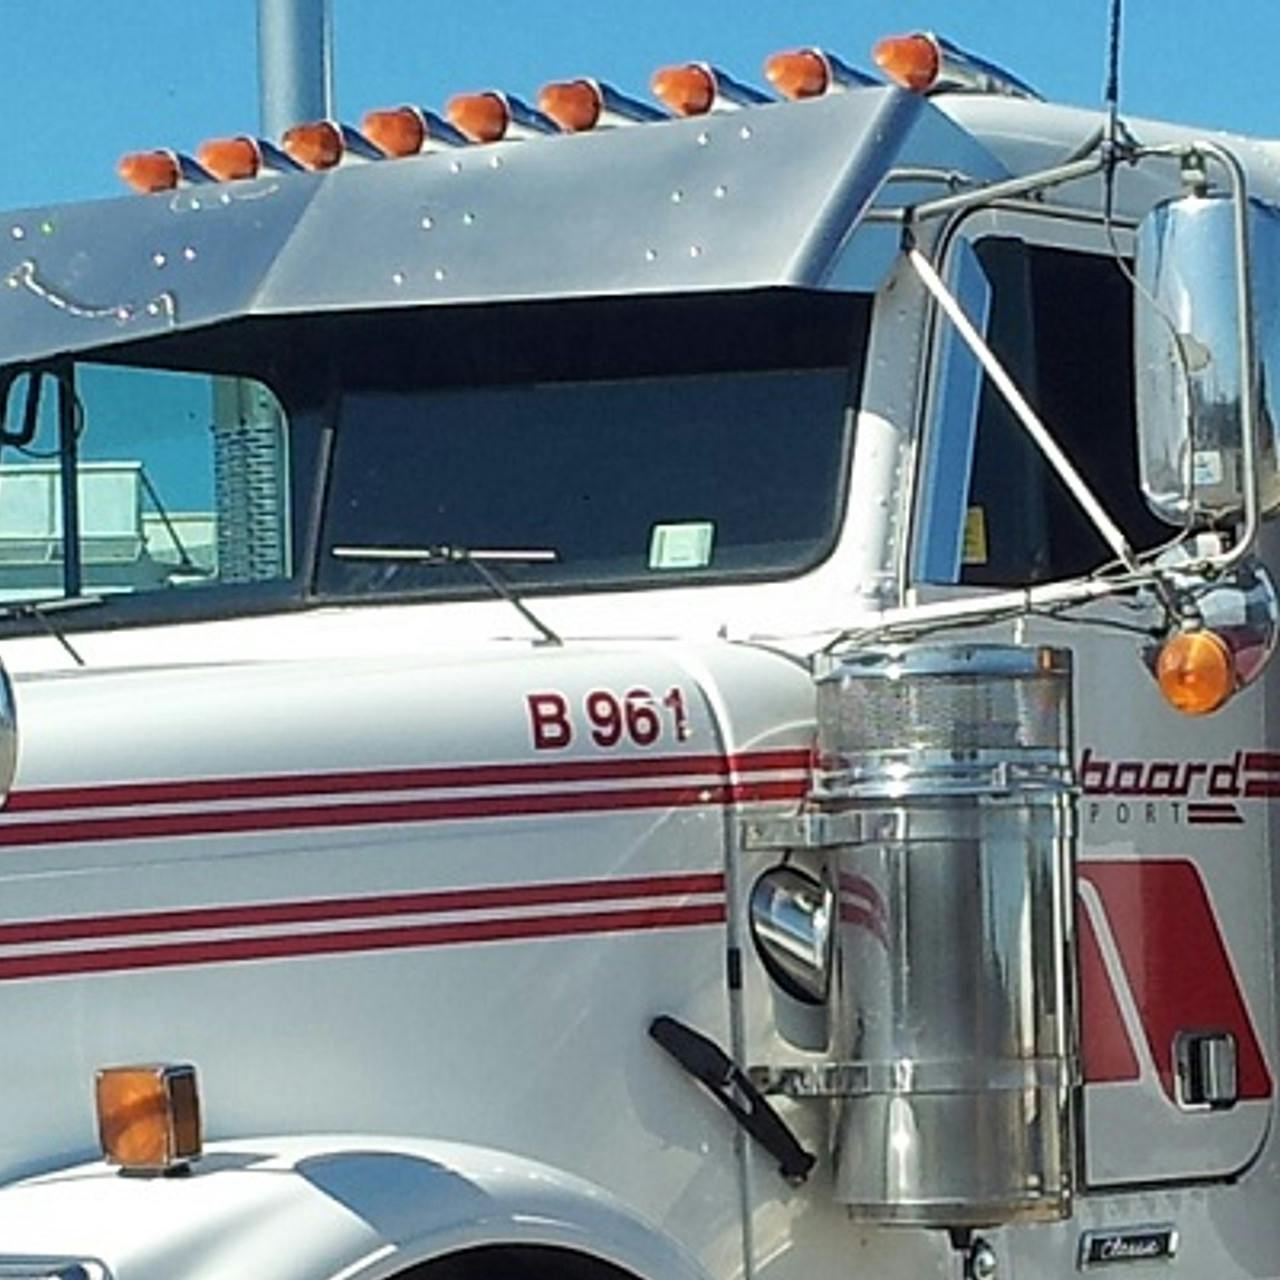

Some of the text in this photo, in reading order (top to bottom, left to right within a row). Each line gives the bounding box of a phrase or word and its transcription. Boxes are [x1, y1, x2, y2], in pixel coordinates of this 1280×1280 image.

[527, 687, 687, 750] B 961
[1080, 748, 1243, 795] board
